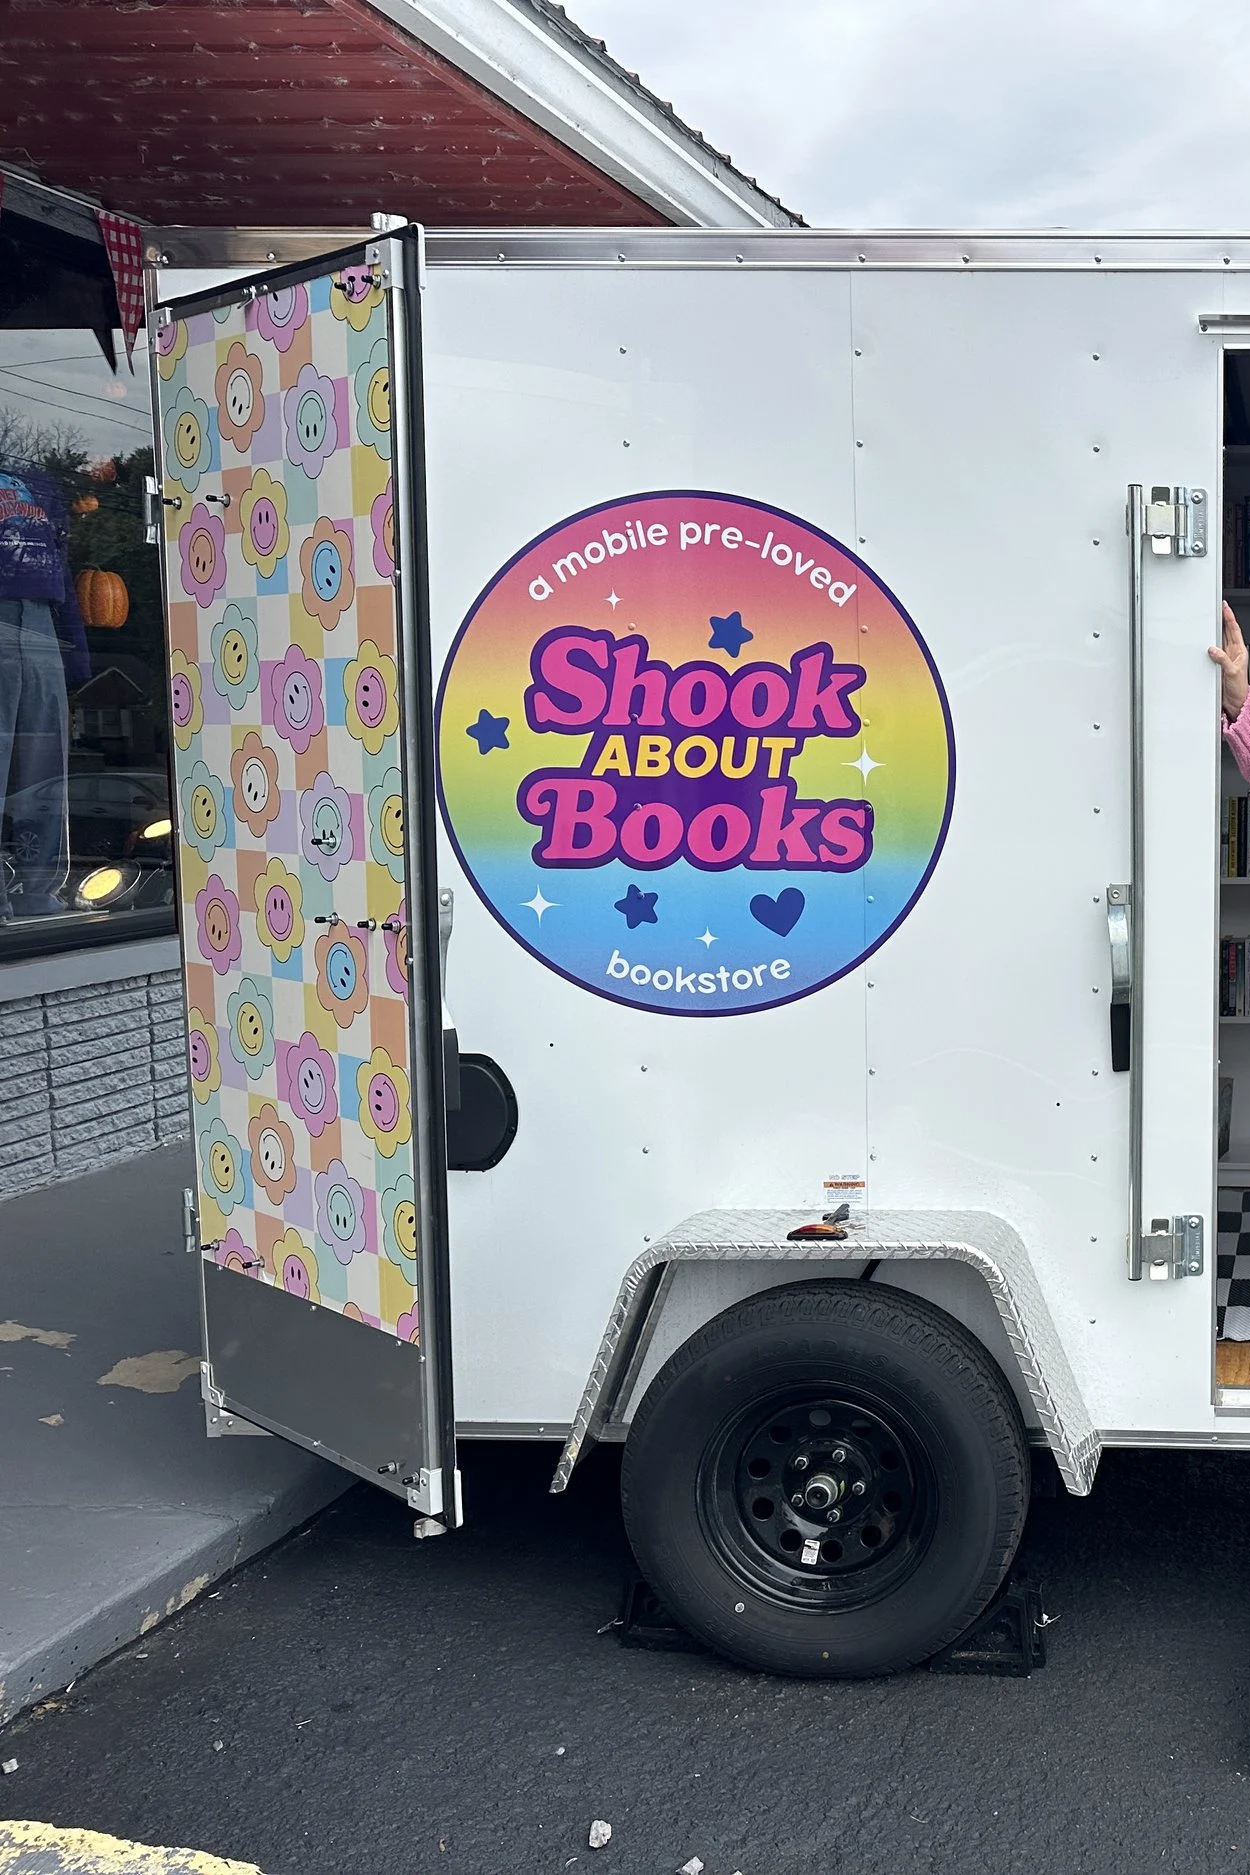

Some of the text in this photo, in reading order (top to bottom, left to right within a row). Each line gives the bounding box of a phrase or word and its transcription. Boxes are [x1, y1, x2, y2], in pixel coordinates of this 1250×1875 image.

[528, 521, 857, 607] a mobile pre-loved
[531, 632, 863, 732] Shook
[591, 734, 796, 779] ABOUT
[524, 776, 868, 865] Books
[605, 949, 791, 994] bookstore
